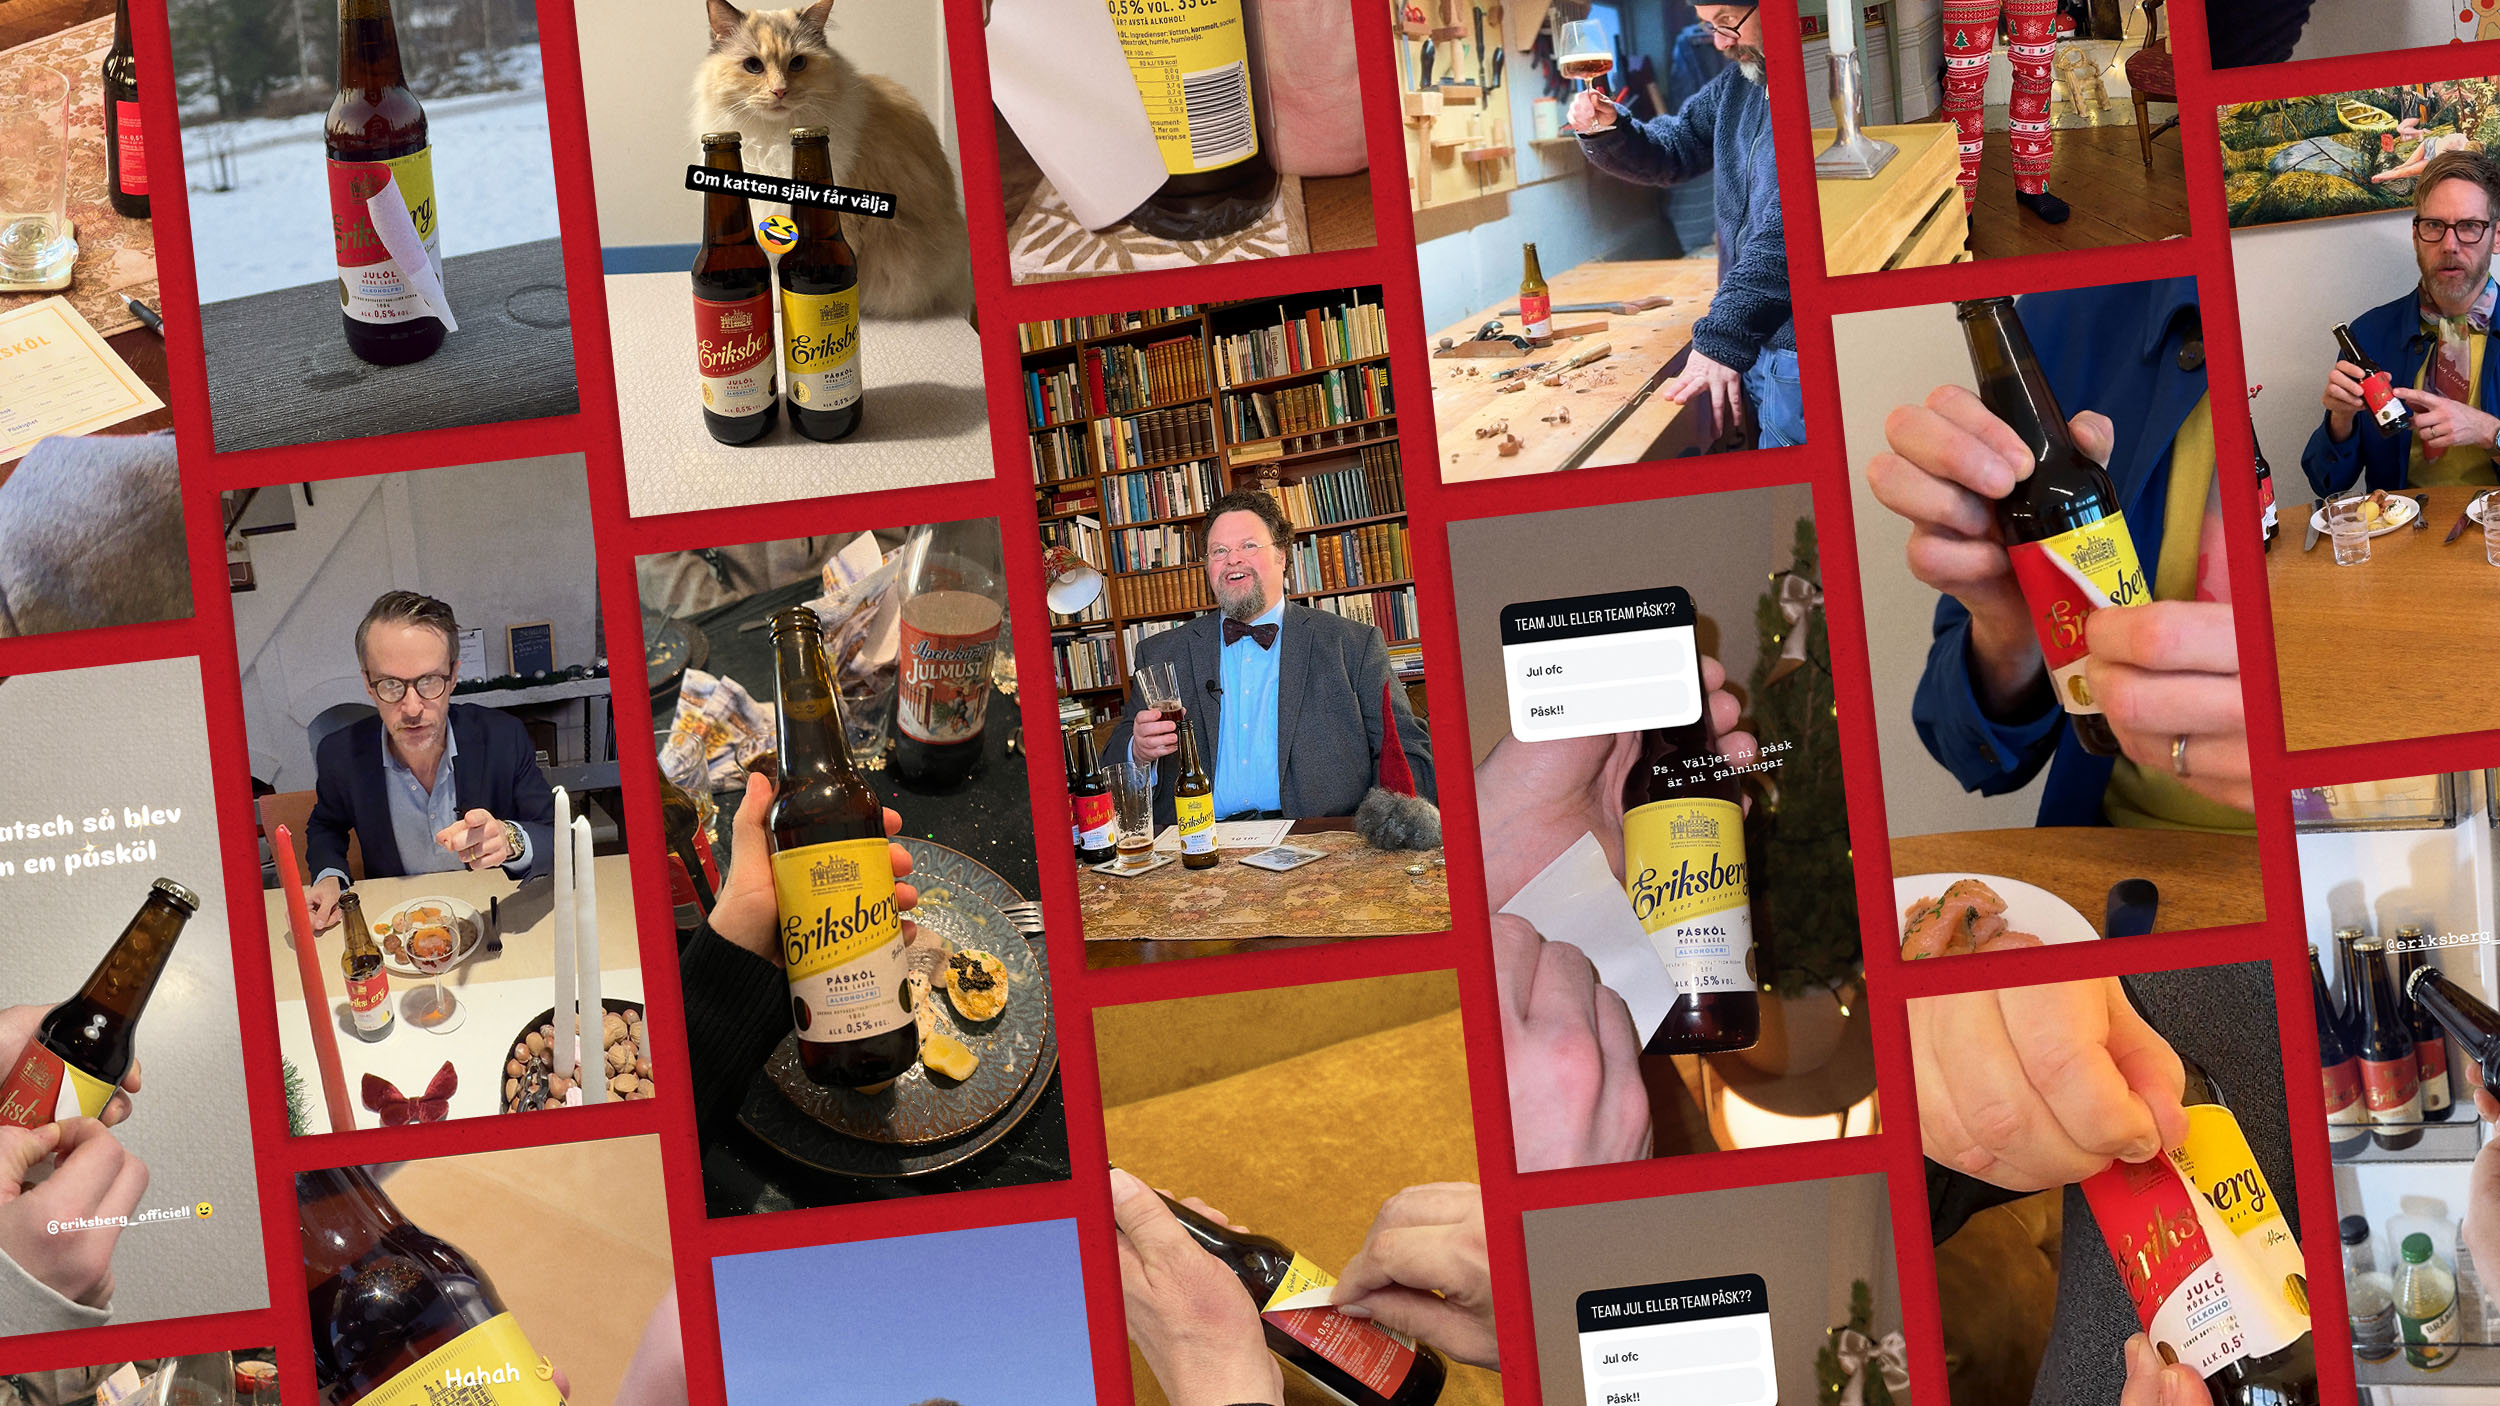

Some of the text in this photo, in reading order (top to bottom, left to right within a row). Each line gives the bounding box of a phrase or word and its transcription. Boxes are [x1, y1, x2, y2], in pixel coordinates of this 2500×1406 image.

[1147, 1, 1174, 13] VOL.
[1129, 17, 1149, 26] AVSTÅ
[1150, 15, 1186, 25] ALKOHOL!
[362, 269, 397, 279] JULÖL
[374, 309, 396, 318] 0,5%
[0, 335, 52, 361] SKÖL
[906, 658, 983, 685] JULMUST
[1632, 852, 1750, 921] Eriksberg
[783, 892, 900, 967] Eriksberg
[1677, 925, 1727, 937] PÅSKÖL
[1678, 947, 1727, 956] ALKOHOLFRI
[826, 969, 876, 986] PÅSKÖL
[829, 990, 877, 1004] ALKOHOLFRI
[829, 1026, 846, 1036] ALK.
[846, 1019, 873, 1034] 0,5%
[2186, 1294, 2210, 1312] MÖRK
[1317, 1312, 1335, 1336] 0,5%
[2202, 1332, 2245, 1368] ALK. 0,5
